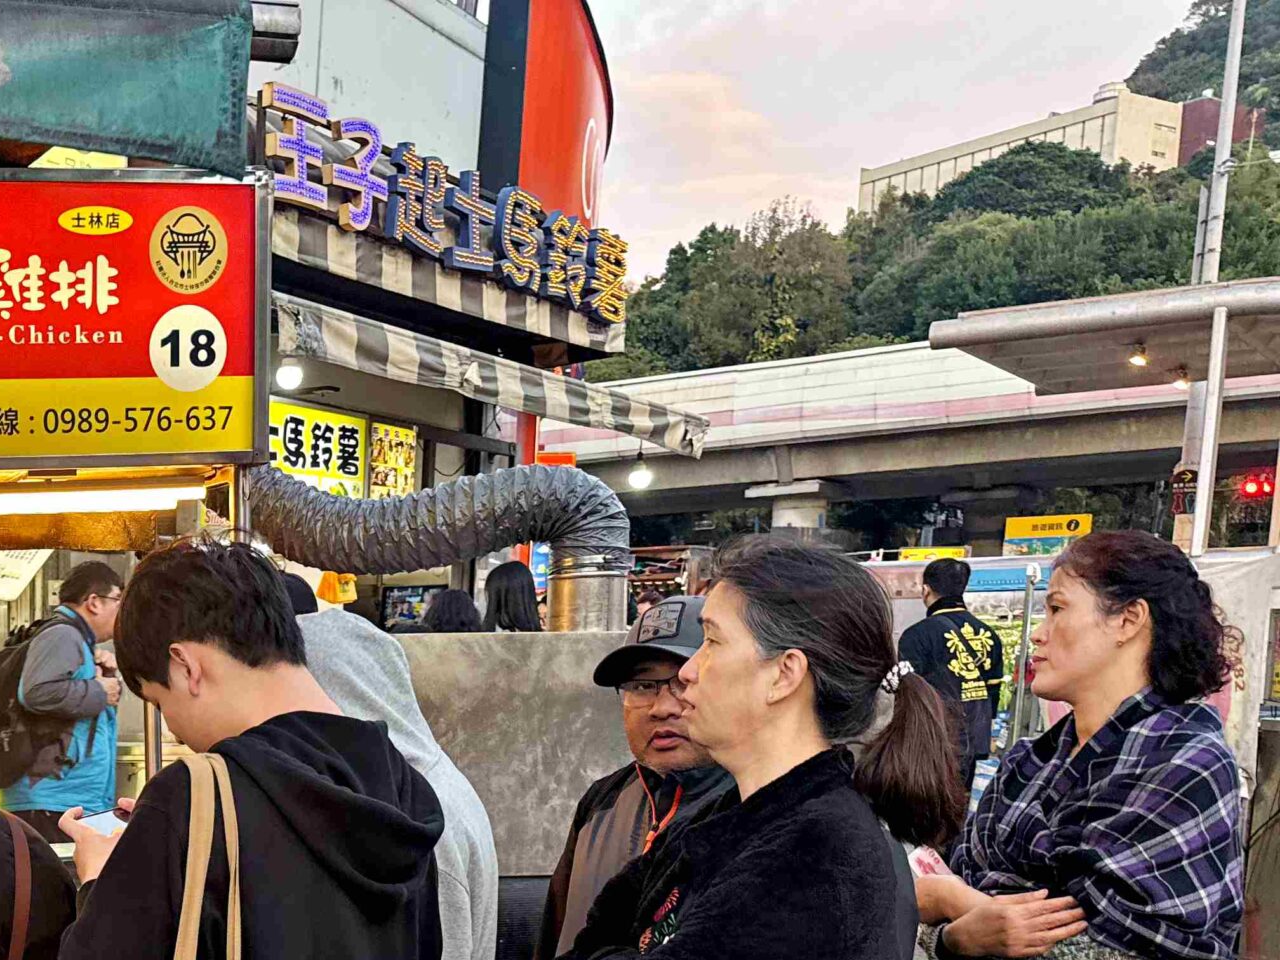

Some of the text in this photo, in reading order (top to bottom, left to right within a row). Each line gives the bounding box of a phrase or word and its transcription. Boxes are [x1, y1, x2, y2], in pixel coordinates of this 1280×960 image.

[70, 211, 121, 230] 士林店
[160, 329, 216, 368] 18
[42, 405, 234, 435] 0989-576-637
